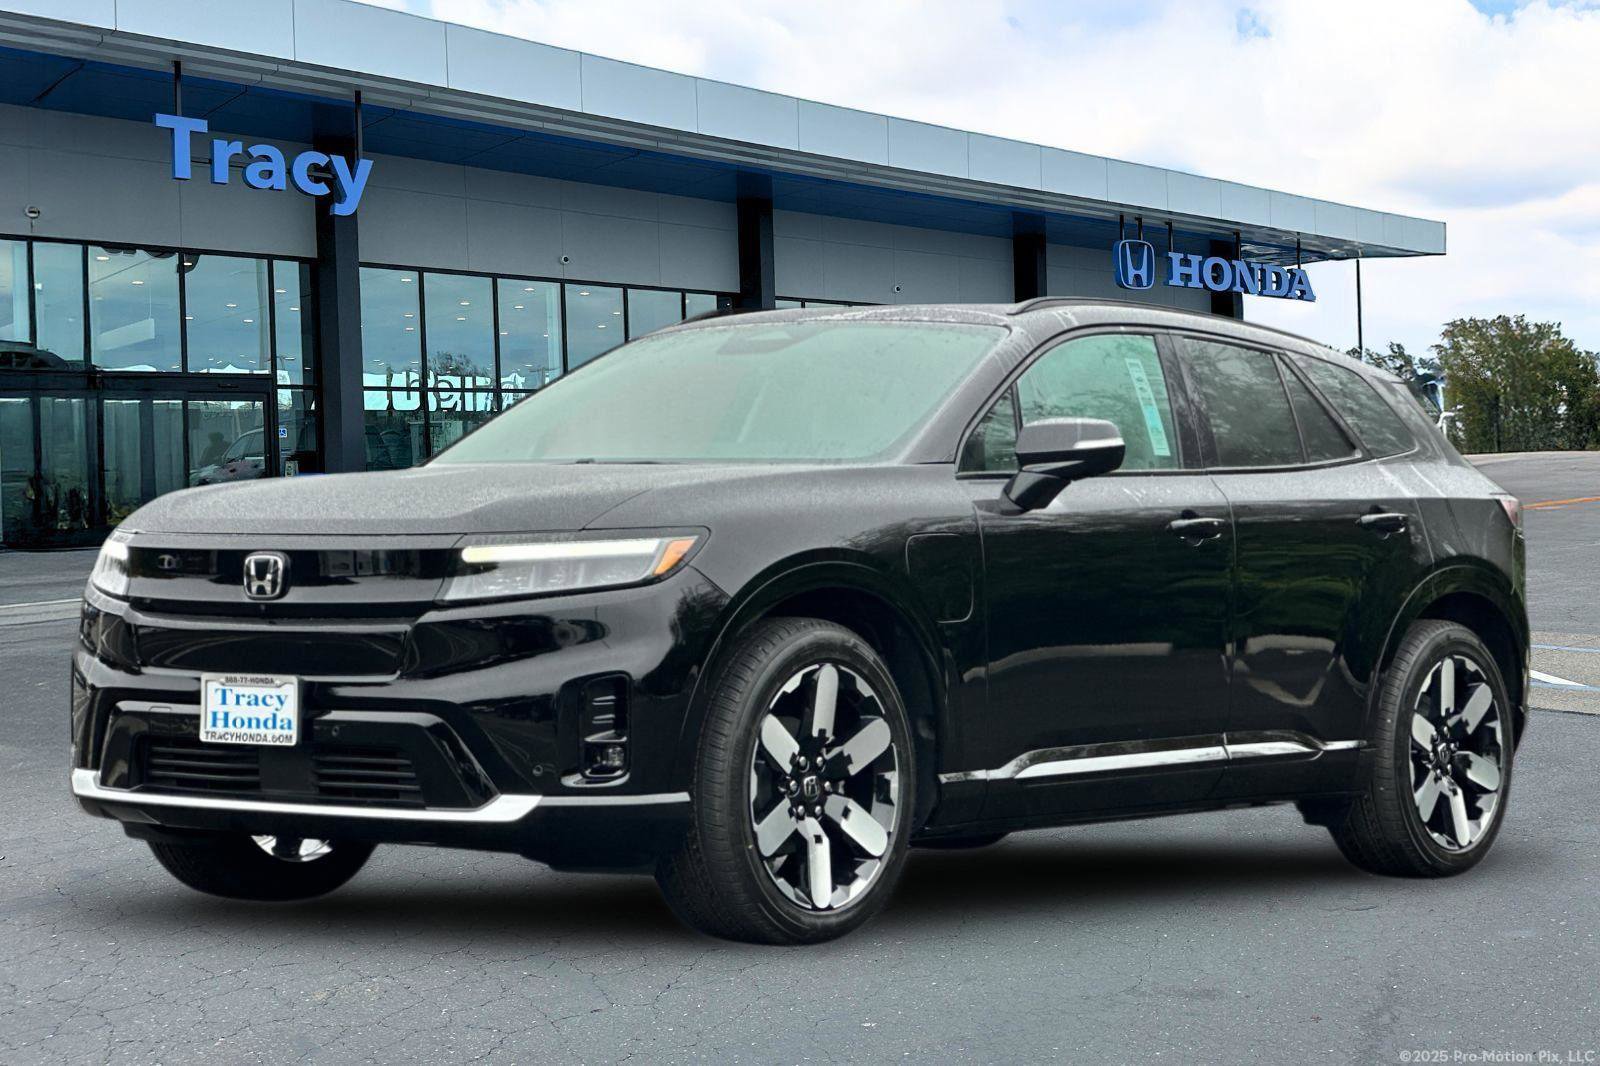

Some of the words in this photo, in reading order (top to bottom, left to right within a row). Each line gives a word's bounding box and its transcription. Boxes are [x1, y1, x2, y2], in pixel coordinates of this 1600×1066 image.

[154, 112, 375, 217] Tracy
[1168, 251, 1317, 302] HONDA
[214, 687, 288, 712] Tracy
[210, 711, 293, 731] Honda
